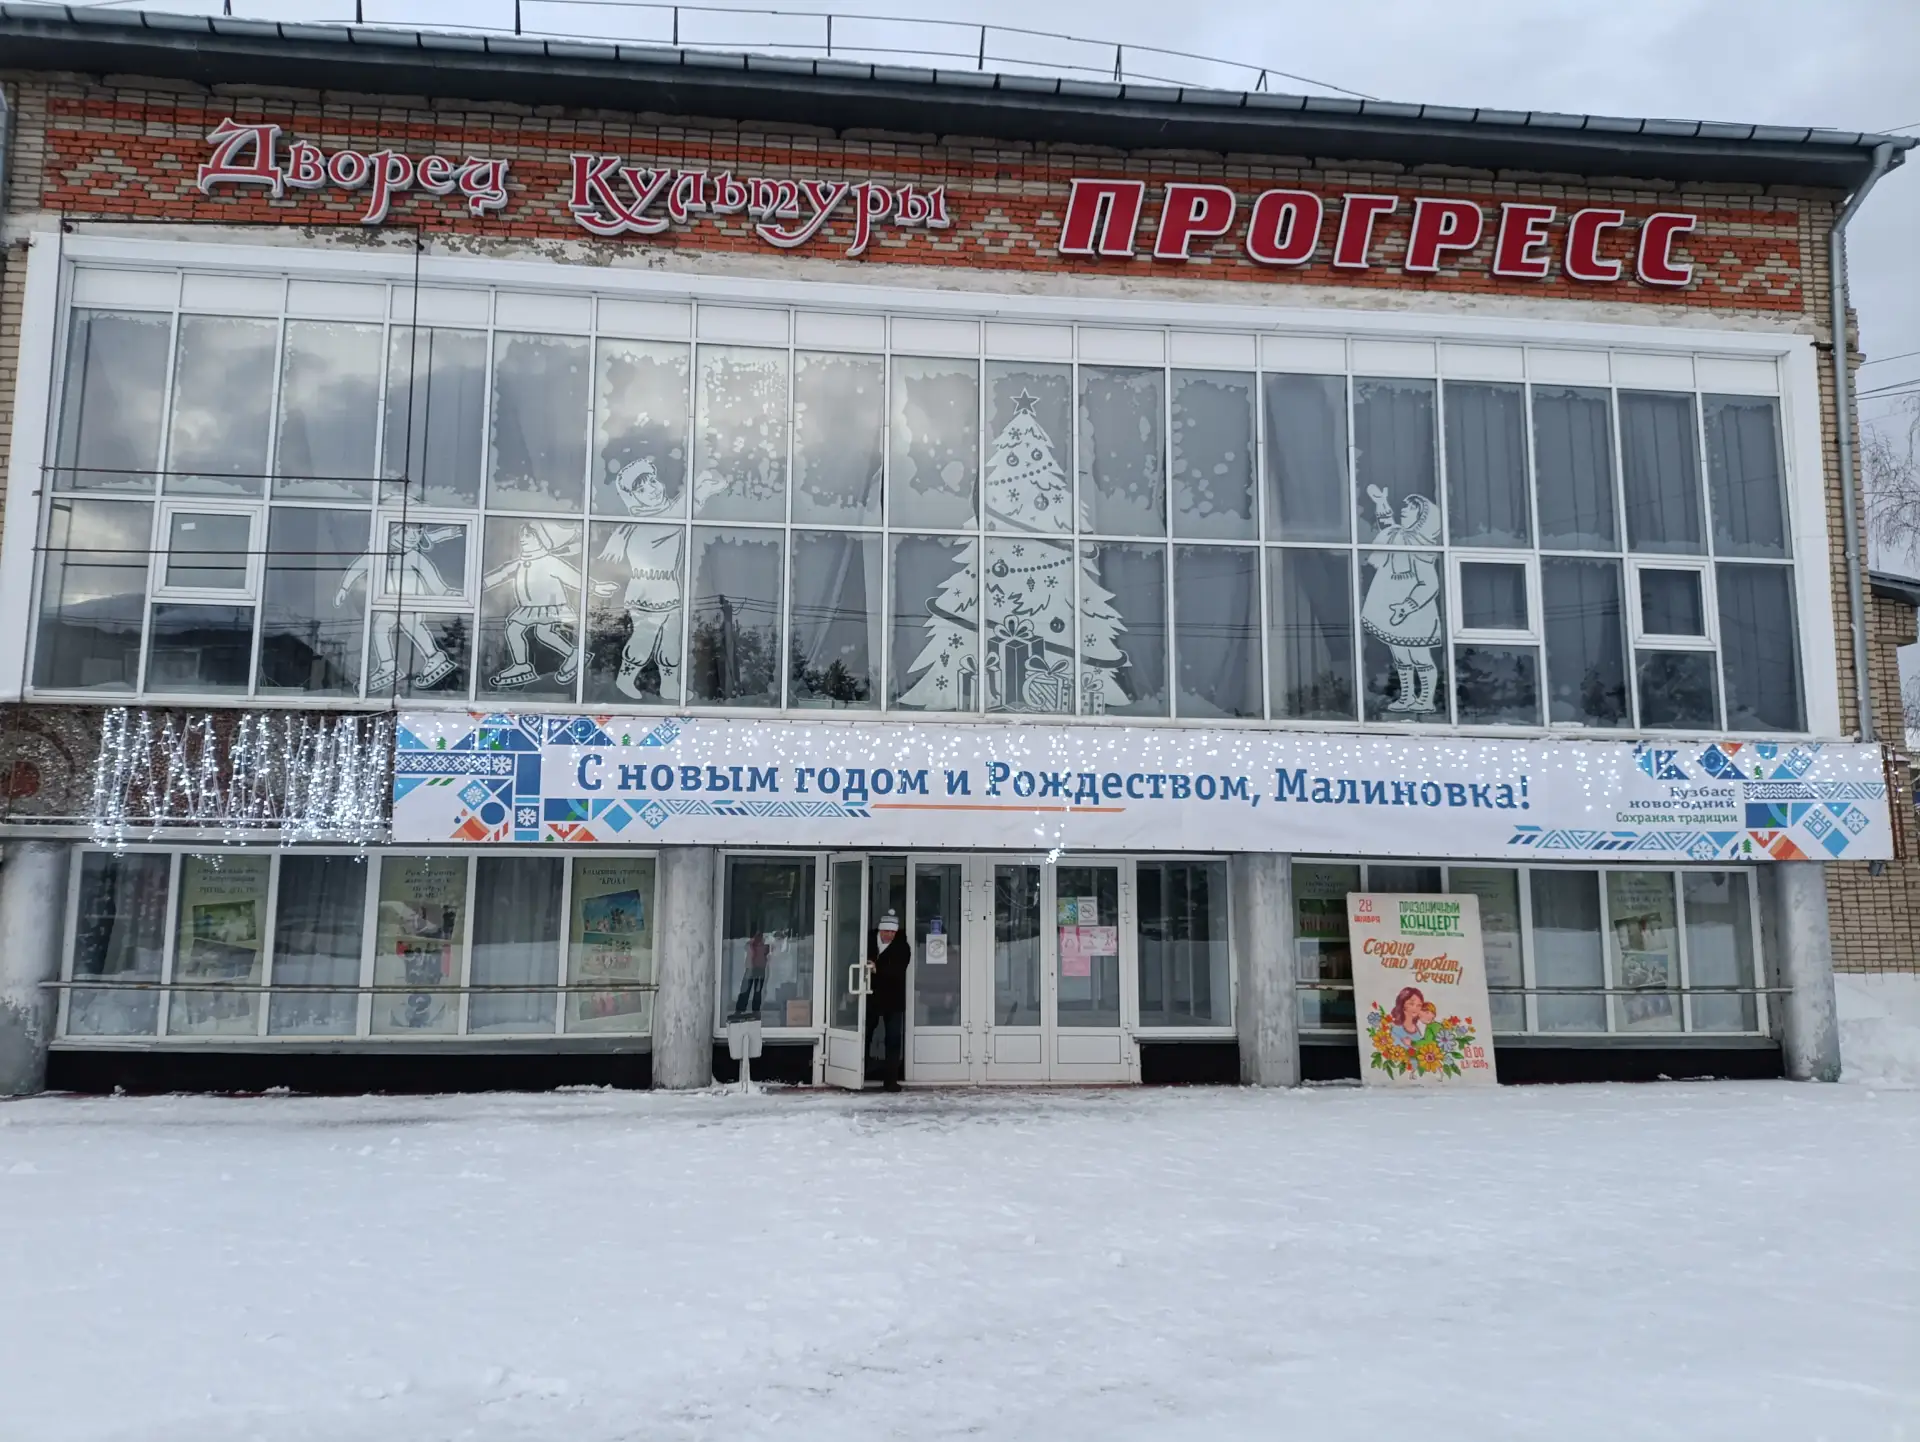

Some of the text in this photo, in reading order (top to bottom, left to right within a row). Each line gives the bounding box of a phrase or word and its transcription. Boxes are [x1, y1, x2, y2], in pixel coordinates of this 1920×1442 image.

[197, 117, 950, 257] Дворец Культуры
[1058, 177, 1697, 286] ПРОГРЕСС
[577, 753, 1531, 810] С новым годом и Рождеством, Малиновка!
[1669, 786, 1735, 799] Кузбасс
[1629, 799, 1736, 810] новогодний
[1616, 812, 1738, 826] Сохраняя традиции
[1358, 899, 1373, 912] 28
[1399, 899, 1460, 914] ПРАЗДНИЧНЫЙ
[1400, 914, 1460, 932] КОНЦЕРТ
[1363, 937, 1415, 957] Сердце
